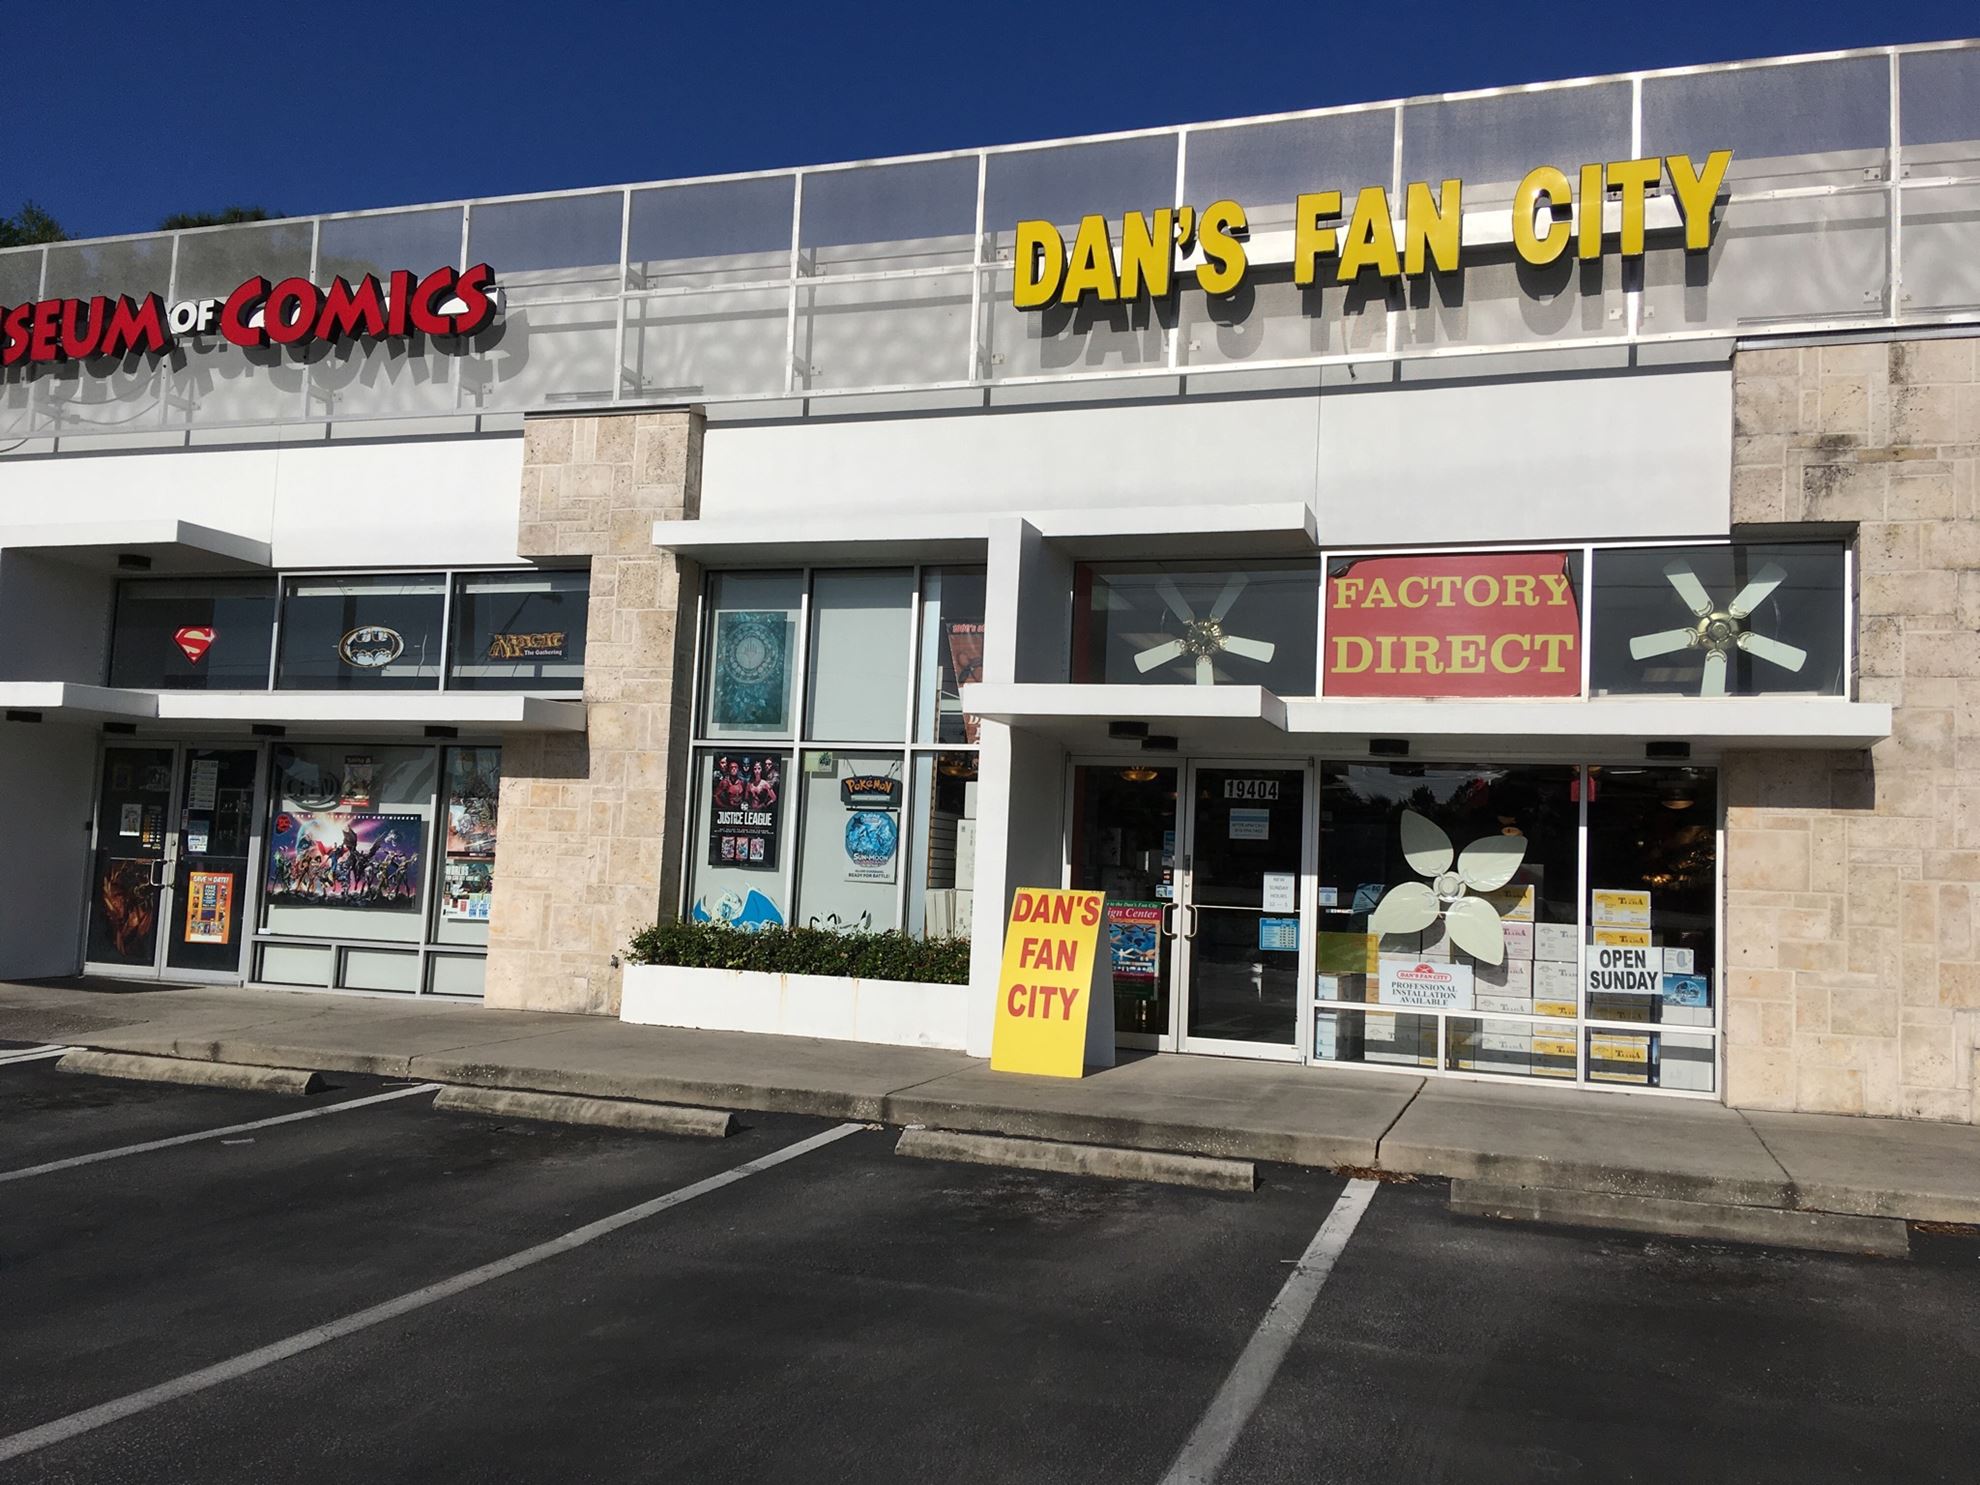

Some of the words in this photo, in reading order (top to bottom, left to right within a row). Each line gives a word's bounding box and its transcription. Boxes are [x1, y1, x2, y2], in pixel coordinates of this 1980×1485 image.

[1013, 199, 1249, 310] DAN'S
[1293, 178, 1463, 287] FAN
[1512, 148, 1734, 265] CITY
[0, 290, 165, 366] SEUM
[169, 299, 215, 334] OF
[220, 262, 489, 347] COMICS
[1332, 574, 1571, 610] FACTORY
[1330, 633, 1573, 675] DIRECT
[1227, 779, 1278, 799] 19404
[717, 811, 744, 825] JUSTICE
[744, 812, 773, 826] LEAGUE
[1012, 893, 1101, 927] DAN'S
[1126, 907, 1158, 919] Center
[1019, 937, 1078, 971] FAN
[1599, 949, 1647, 969] OPEN
[1391, 981, 1457, 992] PROFESSIONAL
[1590, 970, 1659, 991] SUNDAY
[1007, 983, 1080, 1021] CITY
[1392, 988, 1457, 999] INSTALLATION
[1400, 996, 1448, 1006] AVAILABLE
